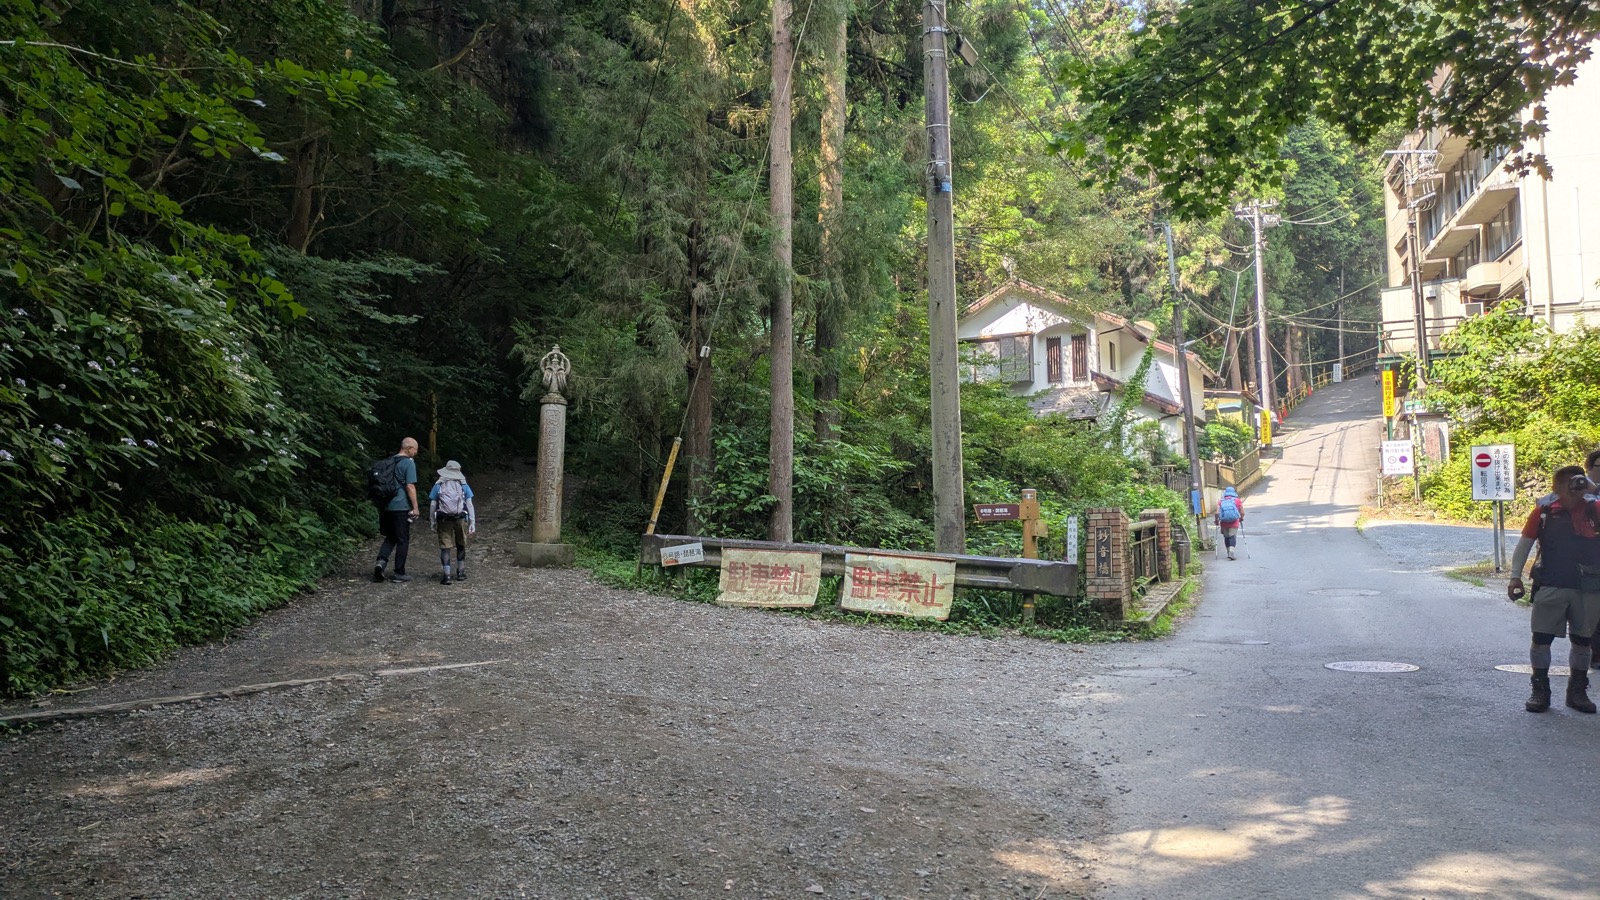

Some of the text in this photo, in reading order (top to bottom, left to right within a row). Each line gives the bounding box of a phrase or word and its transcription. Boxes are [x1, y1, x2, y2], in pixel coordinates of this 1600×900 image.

[1480, 471, 1488, 495] 転回不可
[1494, 449, 1502, 497] 通り抜け出来ません
[1503, 448, 1511, 493] この先私有地の為
[1097, 530, 1110, 575] 妙音橋
[726, 561, 812, 596] 駐車禁止
[851, 566, 945, 607] 駐車禁止
